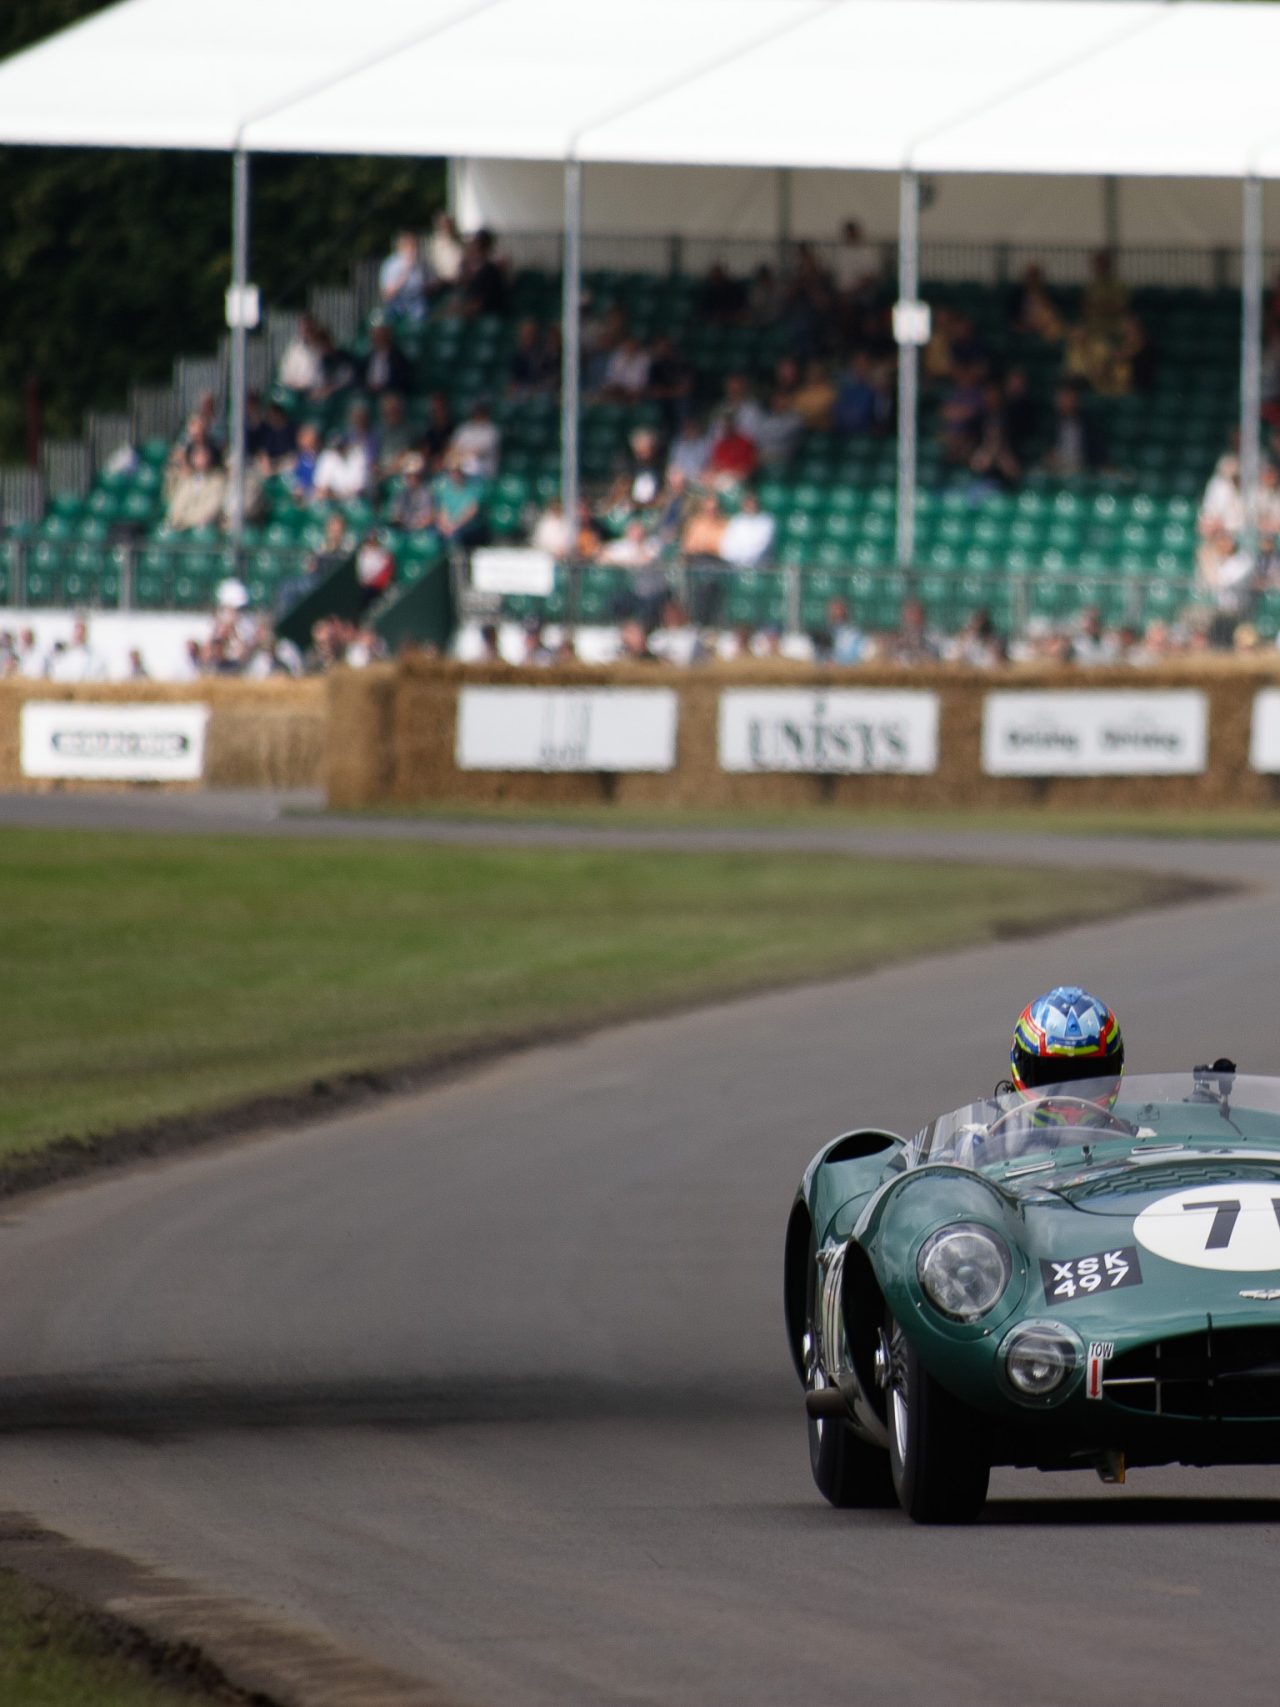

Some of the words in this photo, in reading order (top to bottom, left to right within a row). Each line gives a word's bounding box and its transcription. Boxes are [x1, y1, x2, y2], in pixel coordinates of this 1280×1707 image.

[1050, 1250, 1129, 1281] XSK
[1053, 1266, 1130, 1297] 497
[1090, 1342, 1114, 1358] TOW
